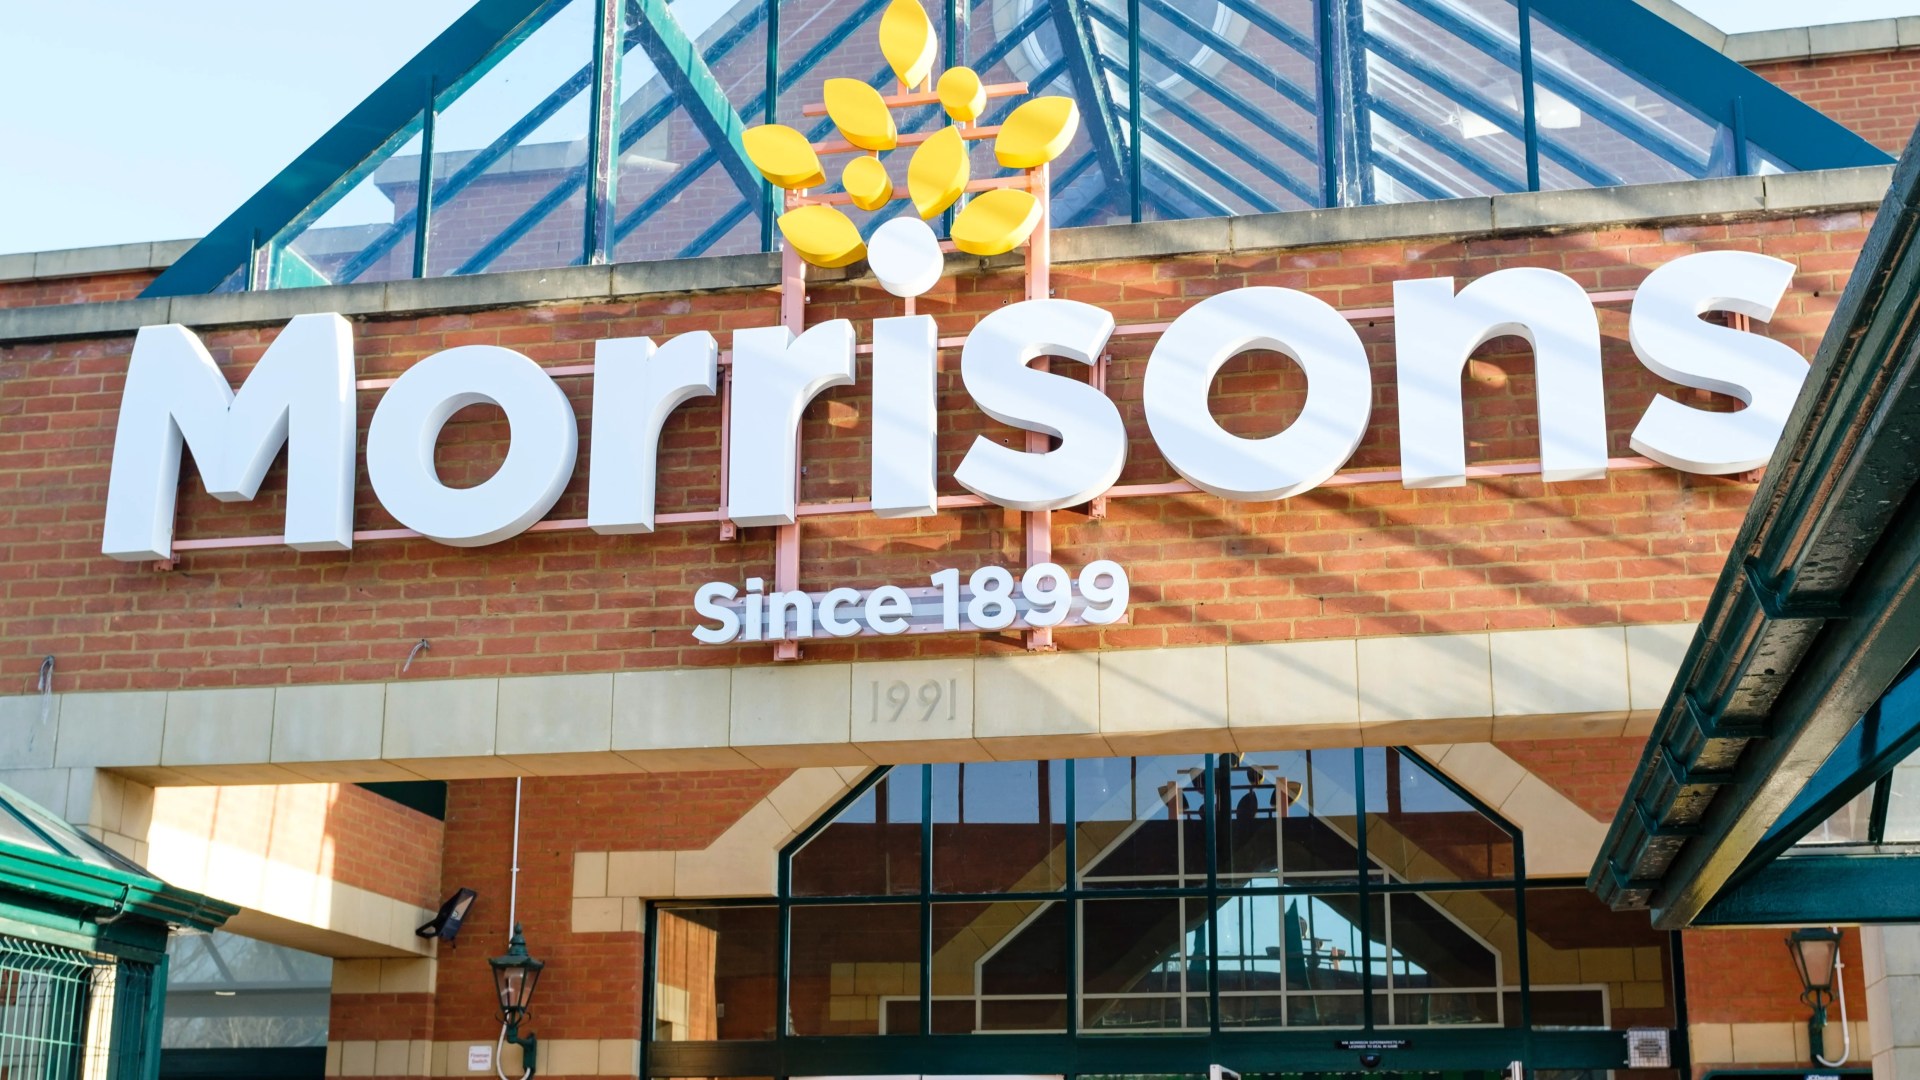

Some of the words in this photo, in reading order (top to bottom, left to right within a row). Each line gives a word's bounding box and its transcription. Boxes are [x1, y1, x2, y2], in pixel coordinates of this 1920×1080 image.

[101, 217, 1811, 562] Morrisons
[692, 577, 912, 645] Since
[931, 561, 1130, 632] 1899
[869, 678, 958, 724] 1991
